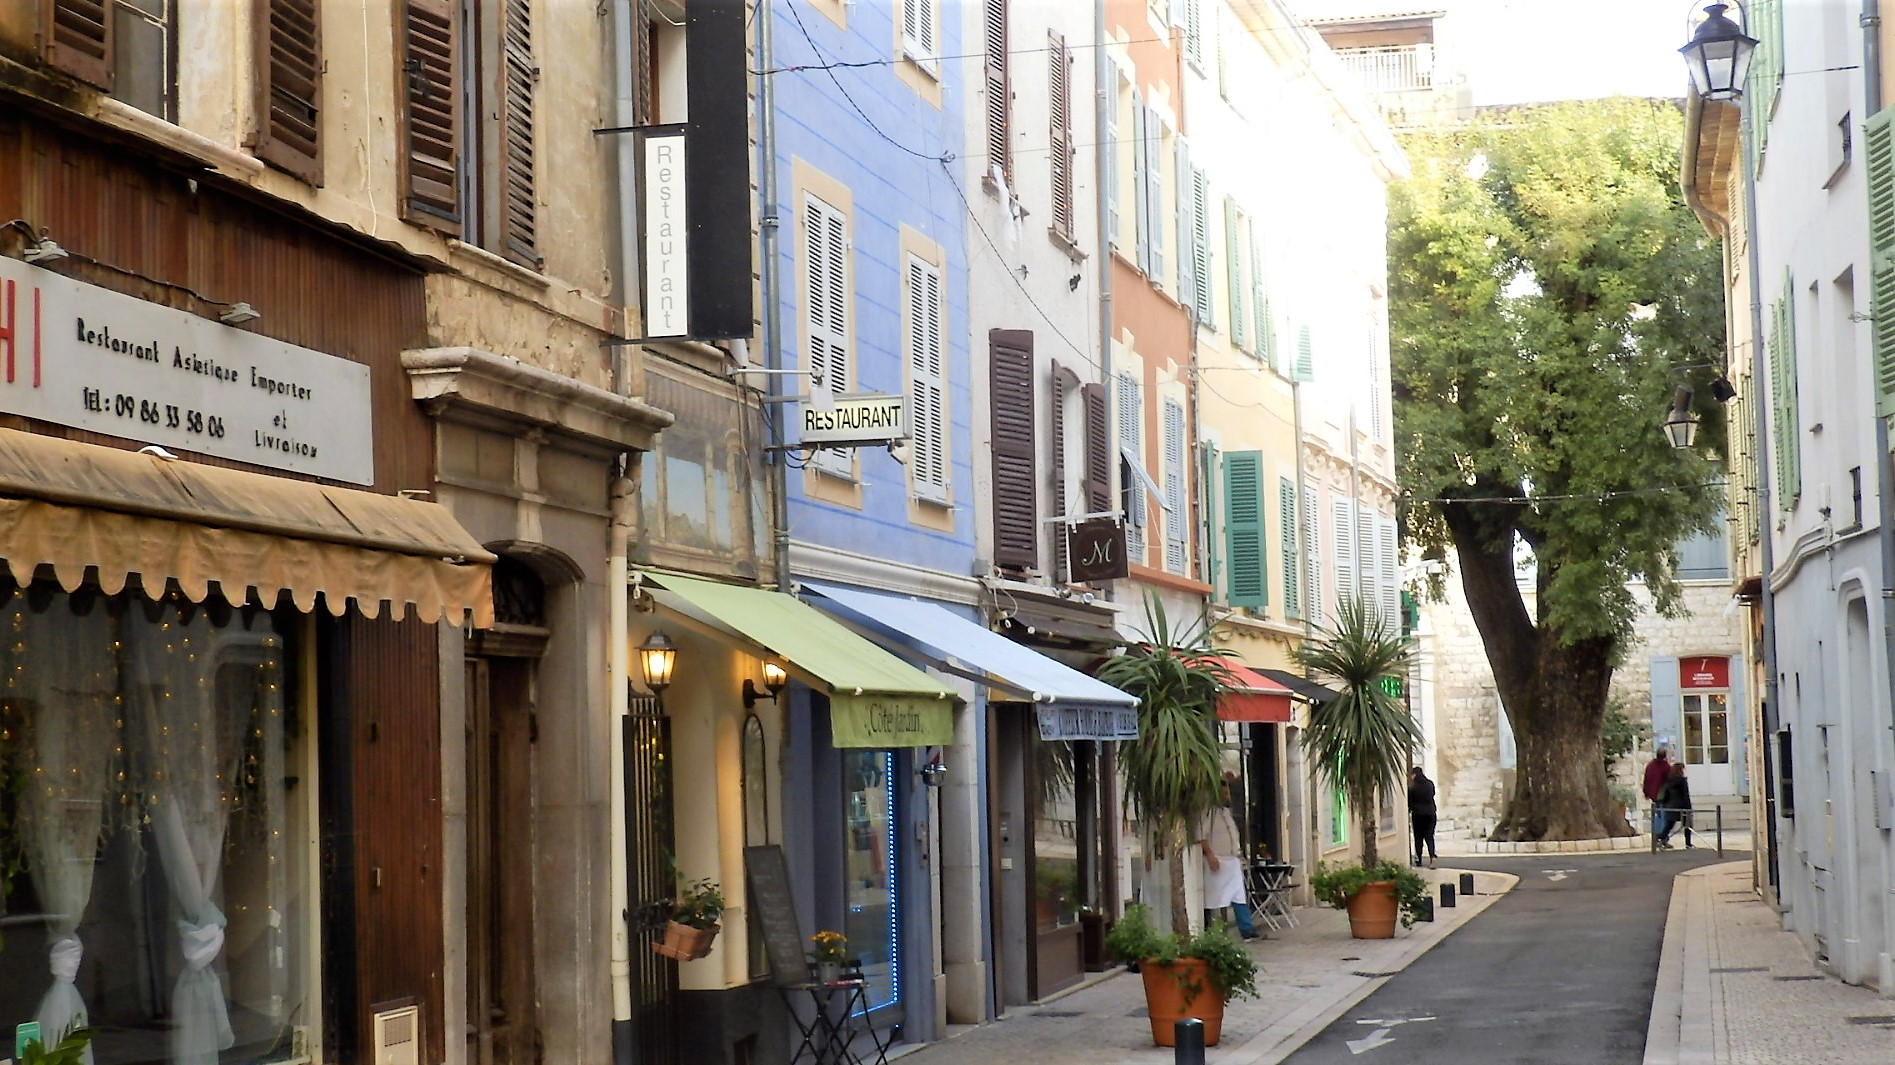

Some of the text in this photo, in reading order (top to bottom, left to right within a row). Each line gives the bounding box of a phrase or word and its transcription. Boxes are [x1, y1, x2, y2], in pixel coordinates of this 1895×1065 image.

[657, 145, 673, 329] Restaurant
[77, 317, 312, 400] Restaurant Asiatique Emporter
[115, 393, 135, 419] 09
[140, 399, 160, 424] 86
[166, 404, 180, 428] 33
[186, 409, 204, 433] 58
[208, 415, 225, 438] 06
[273, 409, 288, 430] et
[805, 405, 901, 431] RESTAURANT
[255, 429, 317, 458] Livraison
[1081, 538, 1112, 566] M
